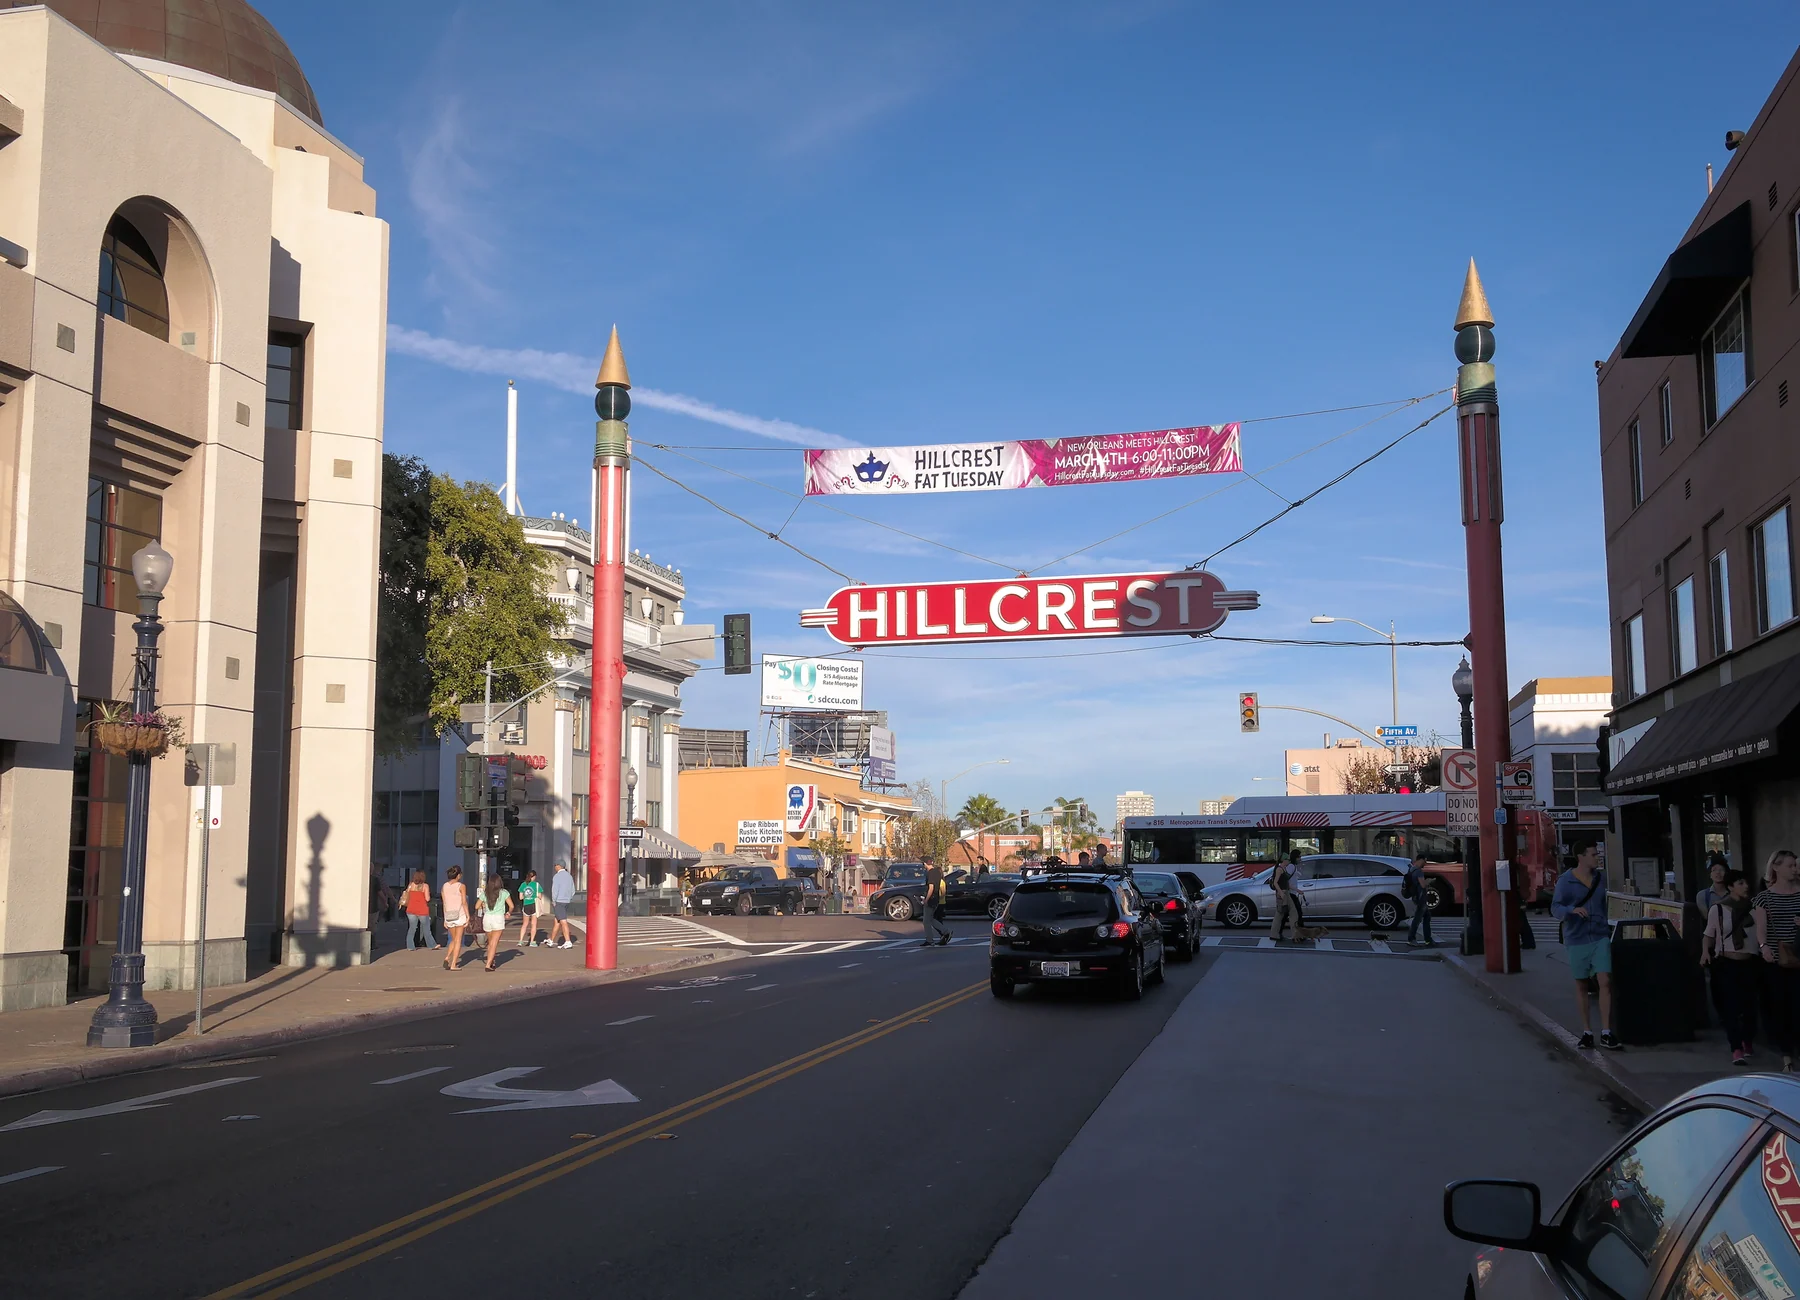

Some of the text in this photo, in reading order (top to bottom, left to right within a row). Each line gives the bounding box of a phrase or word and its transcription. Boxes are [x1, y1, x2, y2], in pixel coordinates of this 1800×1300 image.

[1067, 434, 1195, 452] NEW ORLEANS MEETS HILLCREST
[915, 446, 1004, 470] HILLCREST
[1055, 444, 1210, 469] MARCH 4TH 6:00-11:00PM
[915, 470, 1004, 489] FAT TUESDAY
[848, 577, 1203, 639] HILLCREST
[816, 664, 859, 673] Closing Costs!
[765, 660, 817, 692] Pay $0
[834, 680, 858, 688] Mortgage
[817, 695, 858, 705] sdccu.com
[1448, 798, 1478, 808] DO NOT
[1448, 812, 1479, 822] BLOCK
[757, 820, 779, 828] Ribbon
[760, 835, 783, 843] OPEN
